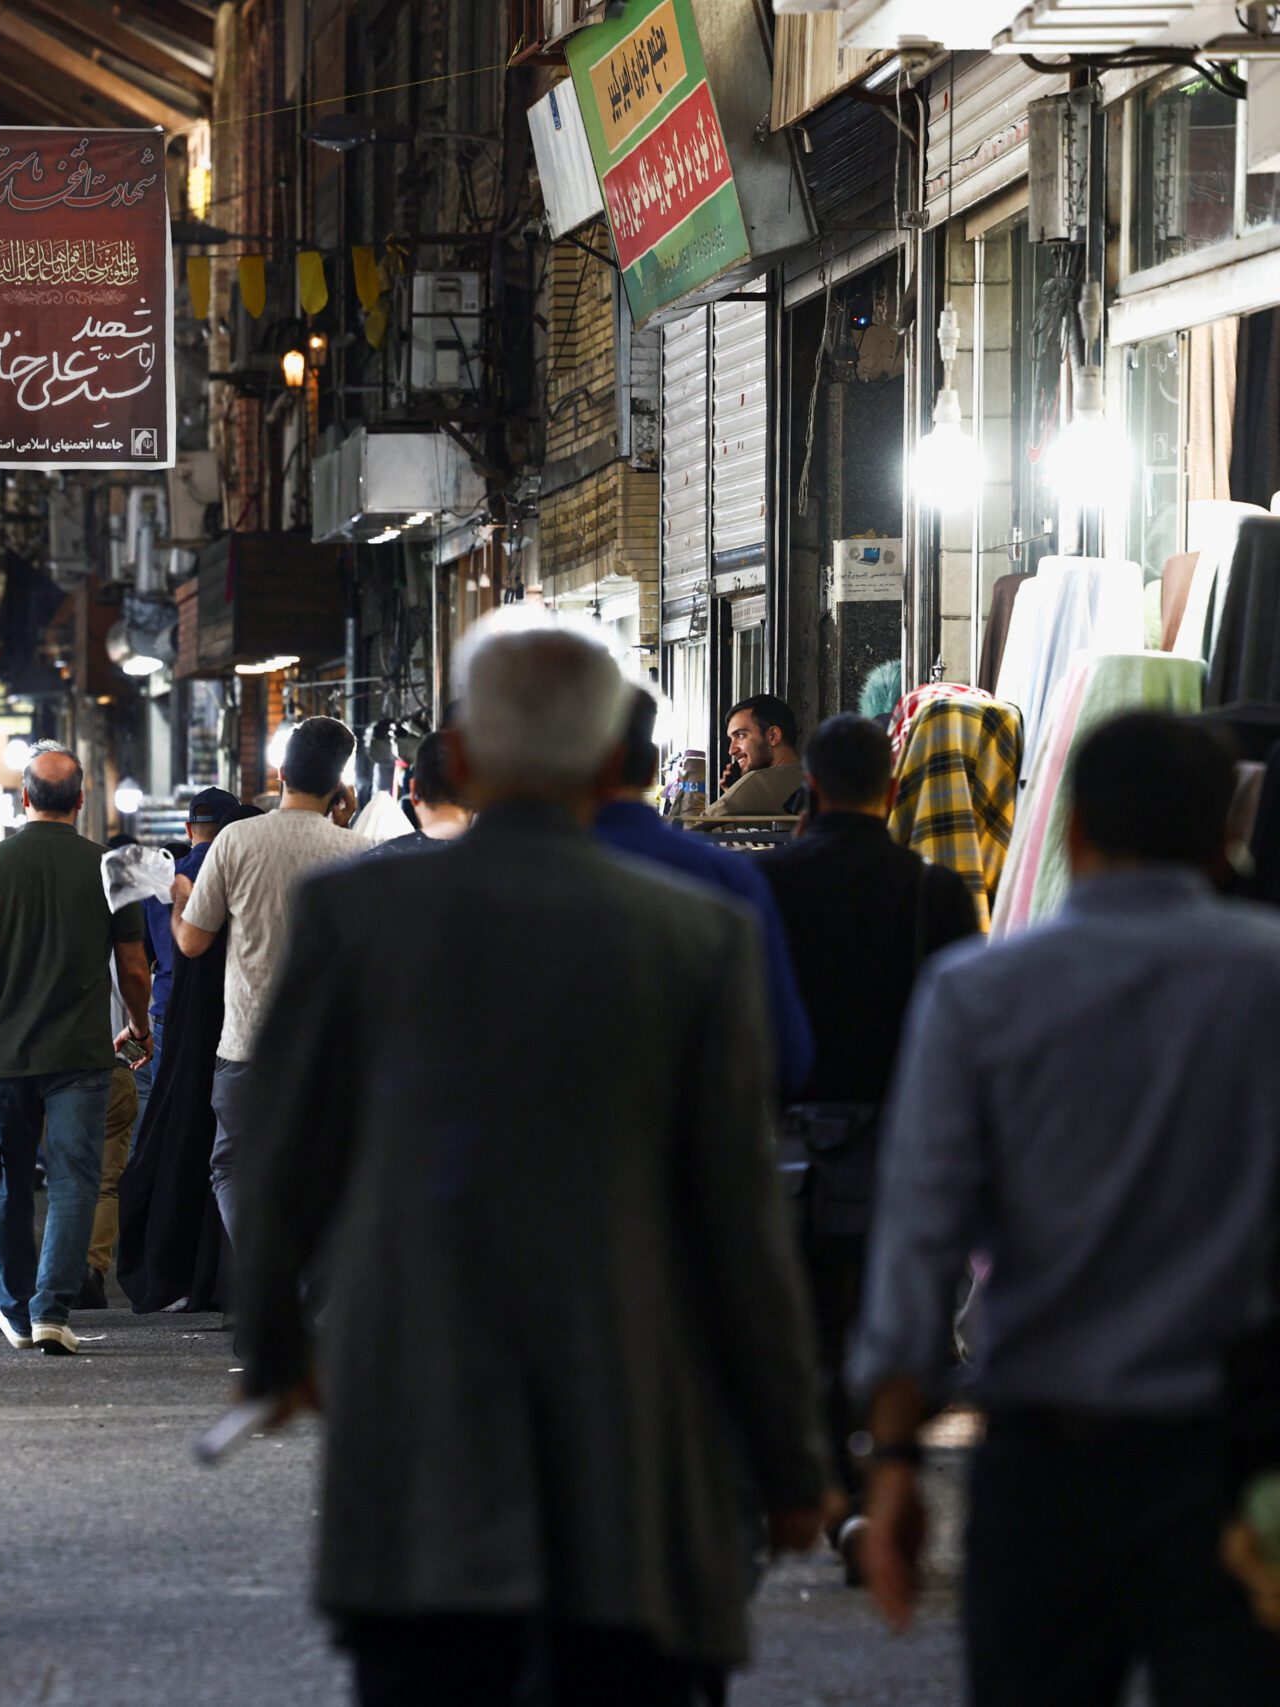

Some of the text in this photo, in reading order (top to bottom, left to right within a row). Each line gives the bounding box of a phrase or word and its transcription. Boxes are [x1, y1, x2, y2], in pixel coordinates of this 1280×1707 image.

[631, 38, 650, 100] تجاری
[647, 26, 668, 95] مجتمع
[63, 148, 156, 208] شهادت
[639, 155, 668, 215] پوشاک
[662, 140, 683, 208] پخش
[672, 129, 694, 198] مرکز
[72, 297, 153, 341] شهید
[17, 351, 99, 411] علی
[16, 437, 50, 454] اسلامی
[95, 437, 124, 454] جامعه
